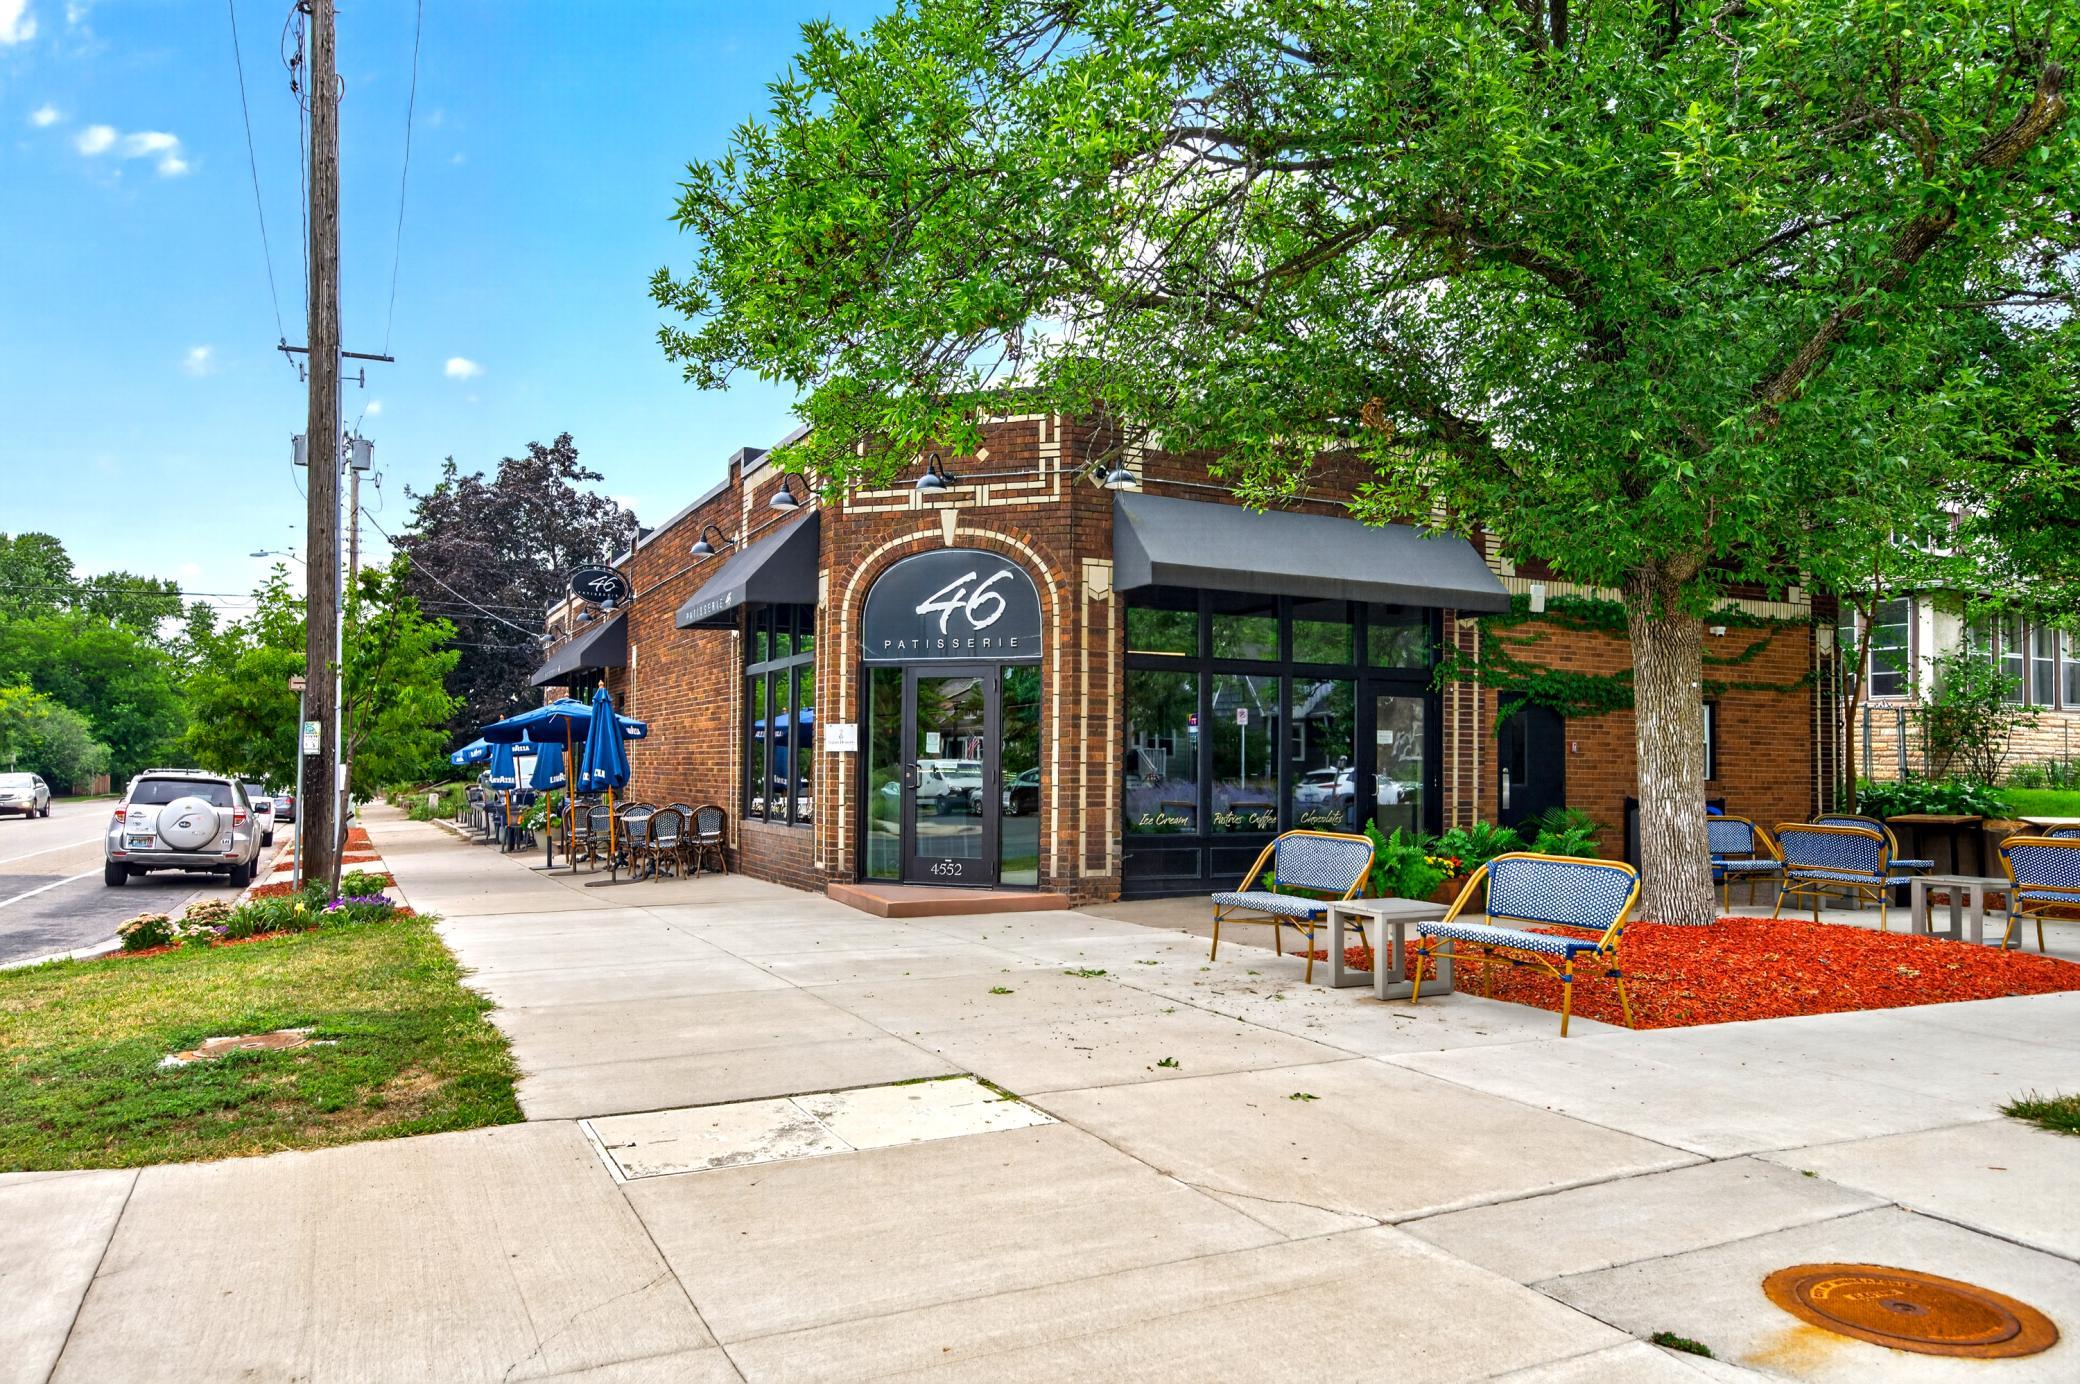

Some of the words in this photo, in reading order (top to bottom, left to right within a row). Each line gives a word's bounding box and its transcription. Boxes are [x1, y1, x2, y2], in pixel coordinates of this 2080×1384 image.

[588, 575, 618, 592] 46
[915, 570, 1014, 635] 46
[884, 637, 1019, 649] PATISSERIE
[1139, 813, 1154, 826] Ice
[1155, 812, 1190, 826] Cream
[1248, 808, 1277, 830] Coffee
[1300, 809, 1345, 826] Chocolates
[930, 863, 962, 876] 4552
